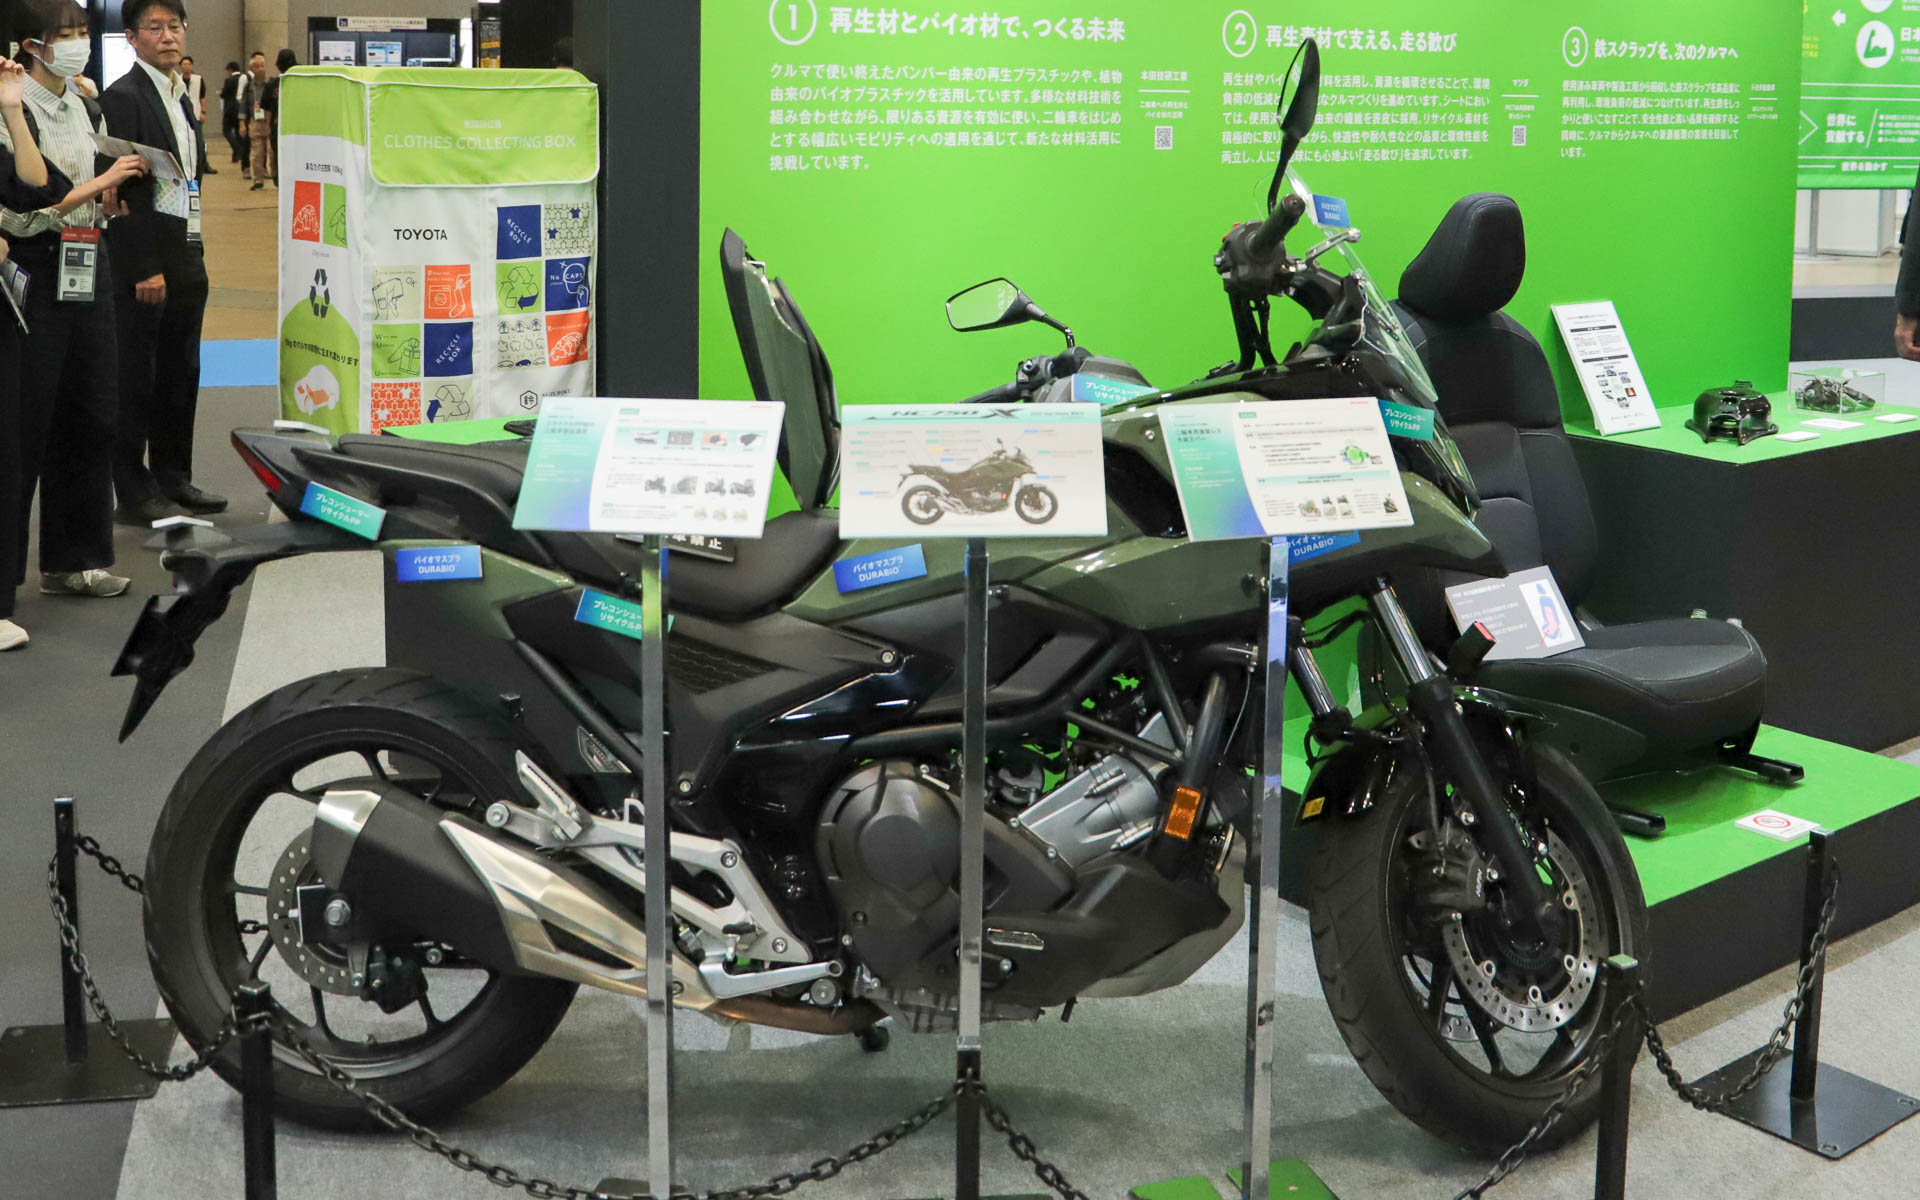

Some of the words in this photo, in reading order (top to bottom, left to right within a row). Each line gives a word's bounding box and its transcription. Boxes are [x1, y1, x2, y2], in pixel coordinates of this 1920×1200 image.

[829, 7, 1126, 42] 再生材とバイオ材で、つくる未来
[1266, 25, 1457, 52] 再生素材で支える、走る歓び
[1594, 38, 1739, 60] 鉄スクラップを、次のクルマへ
[769, 63, 1122, 84] クルマで使い終えたバンパー由来の再生プラスチックや、植物
[769, 86, 1122, 105] 由来のバイオプラスチックを活用しています。多様な材料技術を
[769, 109, 1122, 126] 組み合わせながら、限りある資源を有効に使い、二輪車をはじめ
[384, 134, 451, 149] CLOTHES
[455, 136, 543, 150] COLLECTING
[544, 135, 576, 148] BOX
[769, 155, 870, 171] 挑戦しています。
[394, 229, 447, 240] TOYOTA
[507, 218, 532, 244] RECYCLE
[509, 231, 521, 244] BOX
[435, 333, 461, 364] RECYCLE
[448, 346, 462, 362] BOX
[1385, 408, 1426, 421] プレコンシューマー
[315, 493, 371, 518] プレコンシューマー
[320, 506, 361, 525] リサイクルPP
[1293, 538, 1334, 556] DURABIO
[414, 555, 461, 565] バイオマスプラ
[853, 555, 903, 573] バイオマスプラ
[418, 565, 456, 574] DURABIO
[859, 567, 899, 582] DURABIO
[593, 600, 643, 620] プレコンシュー
[599, 613, 643, 630] リサイクルP
